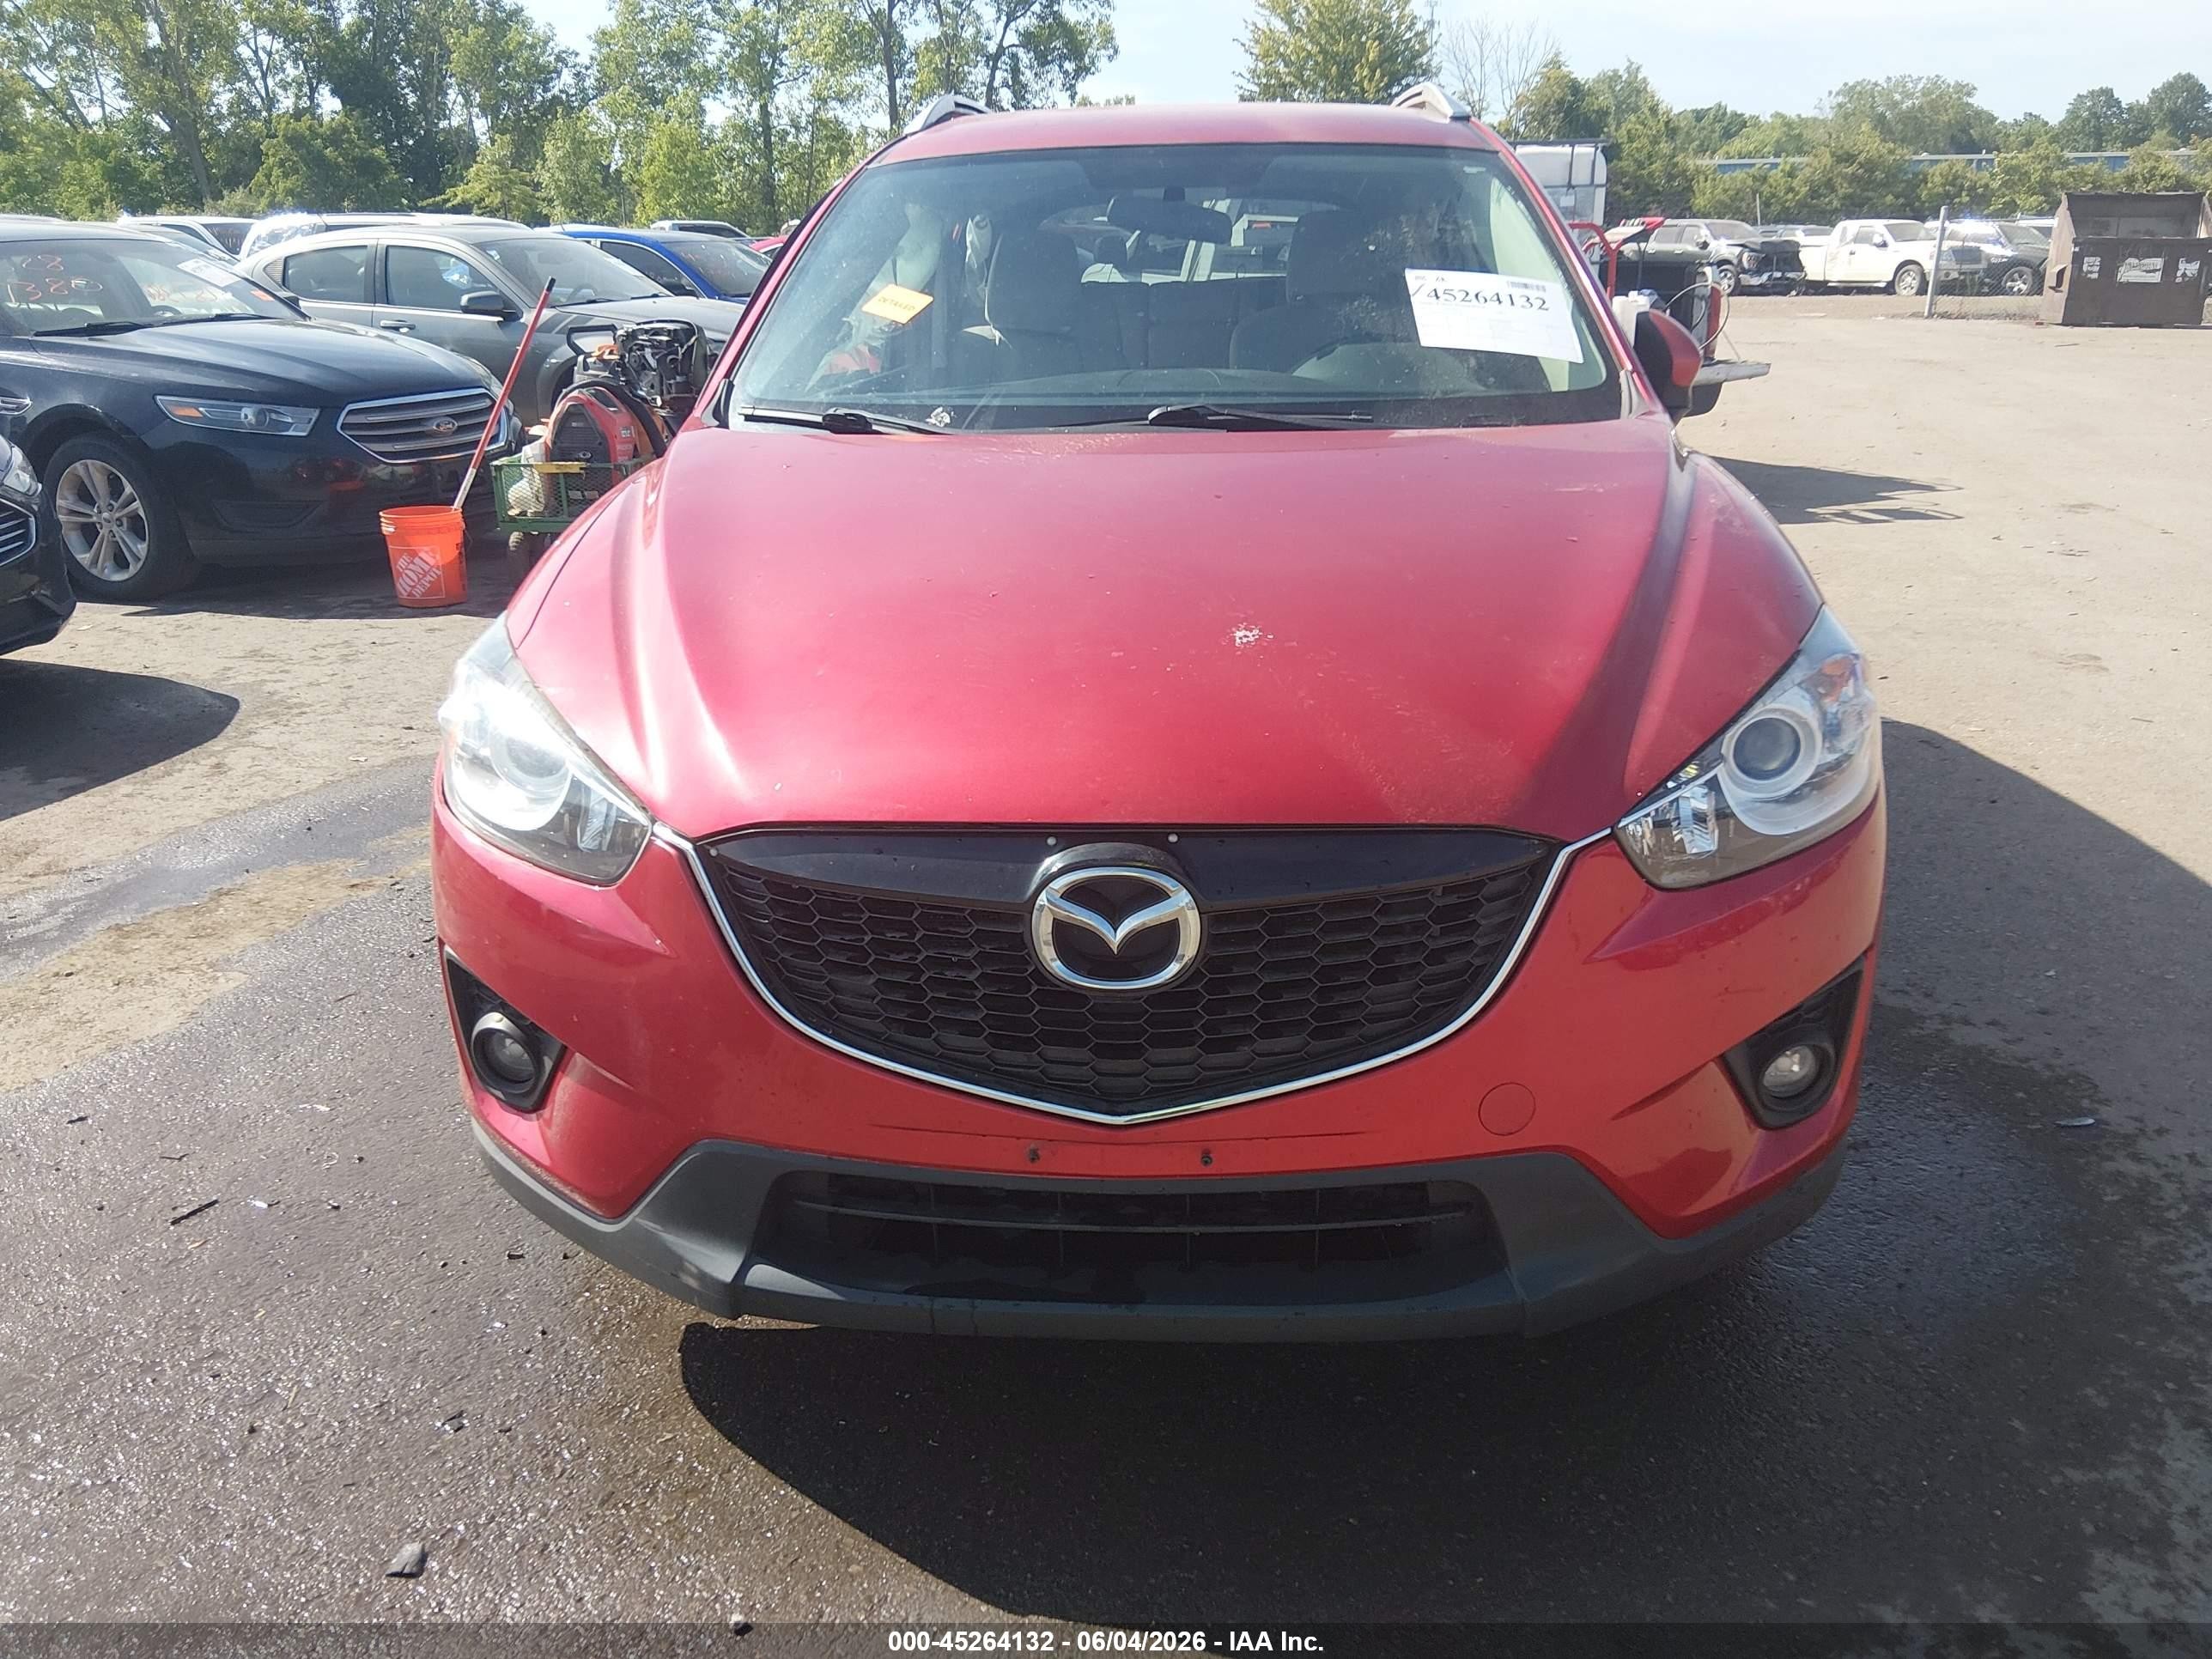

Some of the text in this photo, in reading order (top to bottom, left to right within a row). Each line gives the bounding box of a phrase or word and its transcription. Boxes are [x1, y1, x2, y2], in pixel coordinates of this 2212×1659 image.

[1426, 288, 1549, 312] 45264132
[397, 552, 413, 573] THE
[412, 566, 441, 598] DEPOT
